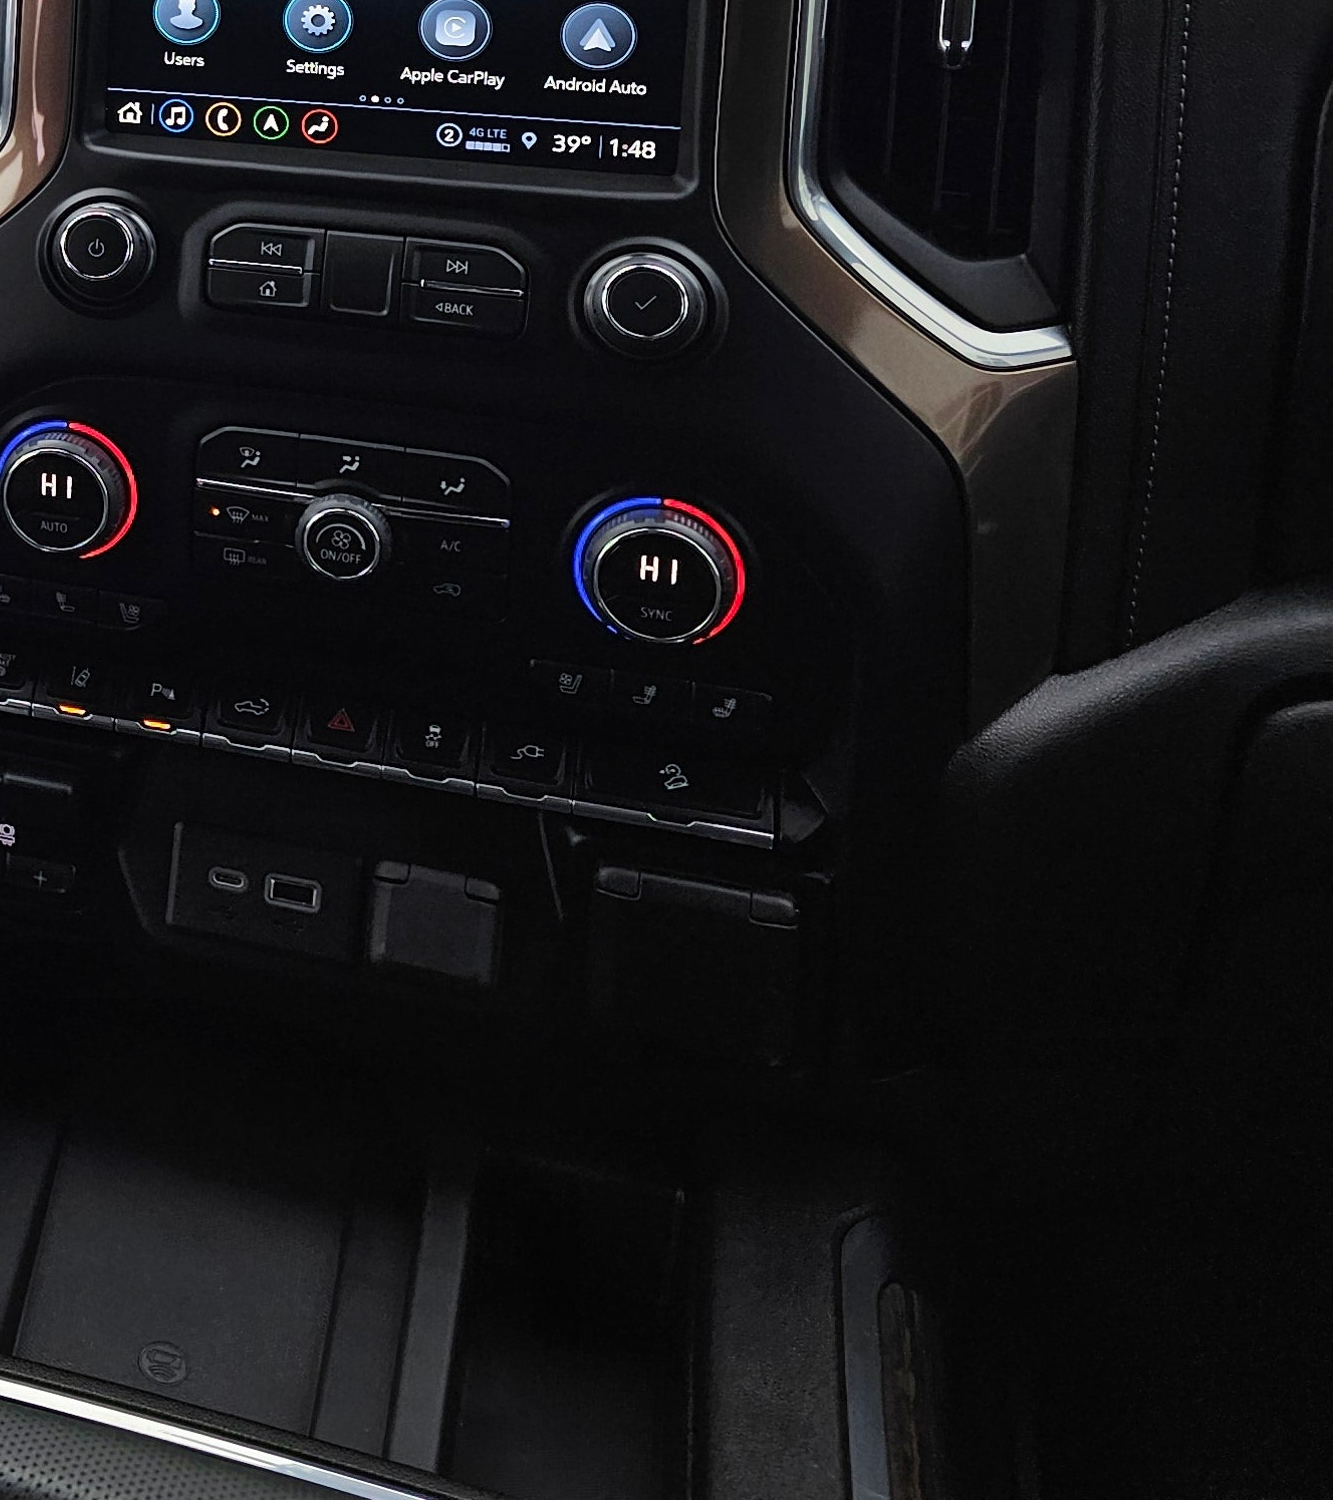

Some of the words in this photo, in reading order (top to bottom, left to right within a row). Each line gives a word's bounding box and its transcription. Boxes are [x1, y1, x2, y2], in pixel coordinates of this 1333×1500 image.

[163, 51, 205, 67] Users
[286, 59, 345, 80] Settings
[400, 67, 444, 84] Apple
[446, 69, 506, 90] CarPlay
[543, 75, 606, 93] Android
[609, 80, 648, 96] Auto
[469, 127, 484, 138] 4G
[487, 128, 508, 139] LTE
[609, 138, 656, 160] 1:48
[444, 302, 474, 316] BACK
[251, 513, 270, 523] MAX
[40, 521, 68, 533] AUTO
[440, 540, 462, 553] A/C
[320, 549, 362, 565] ON/OFF
[640, 606, 674, 621] SYNC
